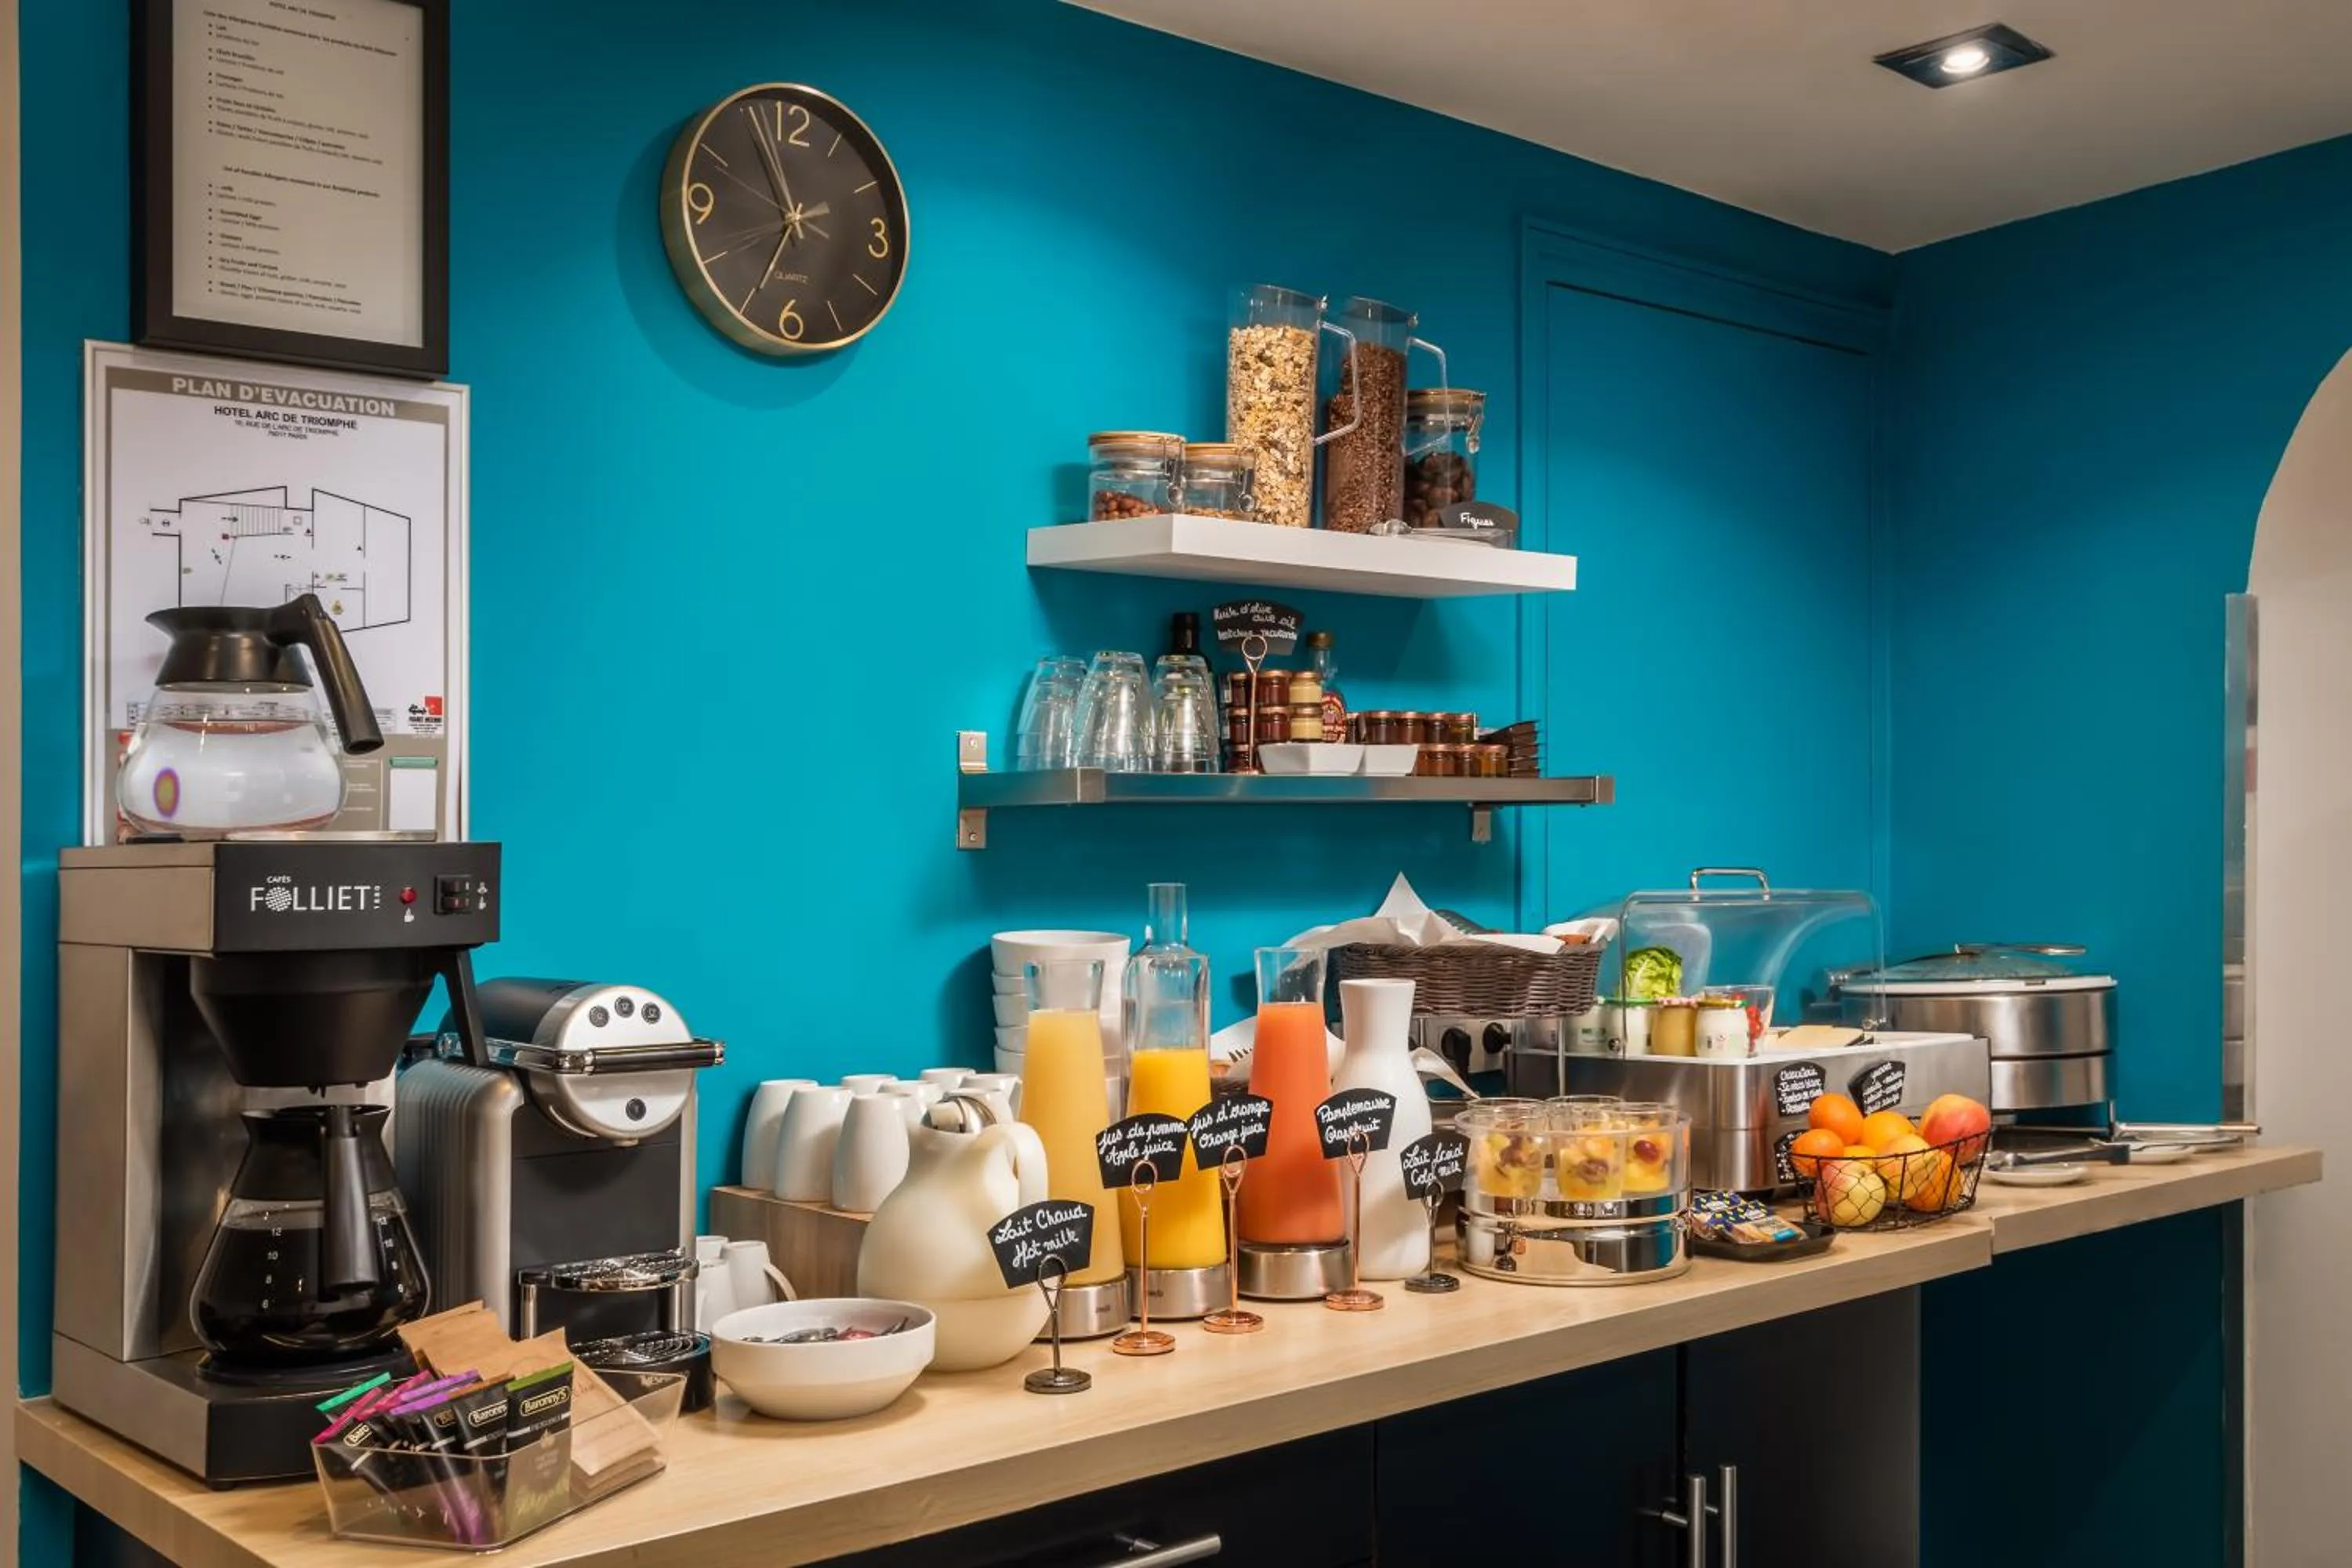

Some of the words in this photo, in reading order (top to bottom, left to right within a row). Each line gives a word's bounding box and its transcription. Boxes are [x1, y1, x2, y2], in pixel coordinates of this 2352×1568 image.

[775, 100, 810, 147] 12
[688, 183, 714, 225] 9
[868, 217, 888, 259] 3
[779, 299, 804, 339] 6
[172, 377, 231, 398] PLAN
[239, 381, 395, 416] D'EVACUATION
[214, 406, 254, 418] HOTEL
[256, 411, 279, 421] ARC
[283, 413, 298, 423] DE
[301, 416, 357, 430] TRIOMPHE
[1461, 512, 1494, 530] Figues
[250, 885, 371, 912] FOLLIET
[1191, 1114, 1213, 1139] jus
[1216, 1098, 1271, 1123] d'orange
[1240, 1121, 1266, 1144] juice
[1098, 1129, 1123, 1154] jus
[1127, 1123, 1145, 1138] de
[1145, 1121, 1188, 1142] pomme
[1105, 1145, 1138, 1166] Apple
[1142, 1141, 1177, 1161] juice
[1403, 1145, 1430, 1169] Lait
[1411, 1168, 1436, 1185] Cold
[272, 1227, 281, 1236] 12
[995, 1216, 1033, 1244] Lait
[1036, 1205, 1087, 1229] Chaud
[267, 1250, 278, 1260] 10
[1012, 1240, 1042, 1268] Hot
[1043, 1228, 1079, 1250] milk
